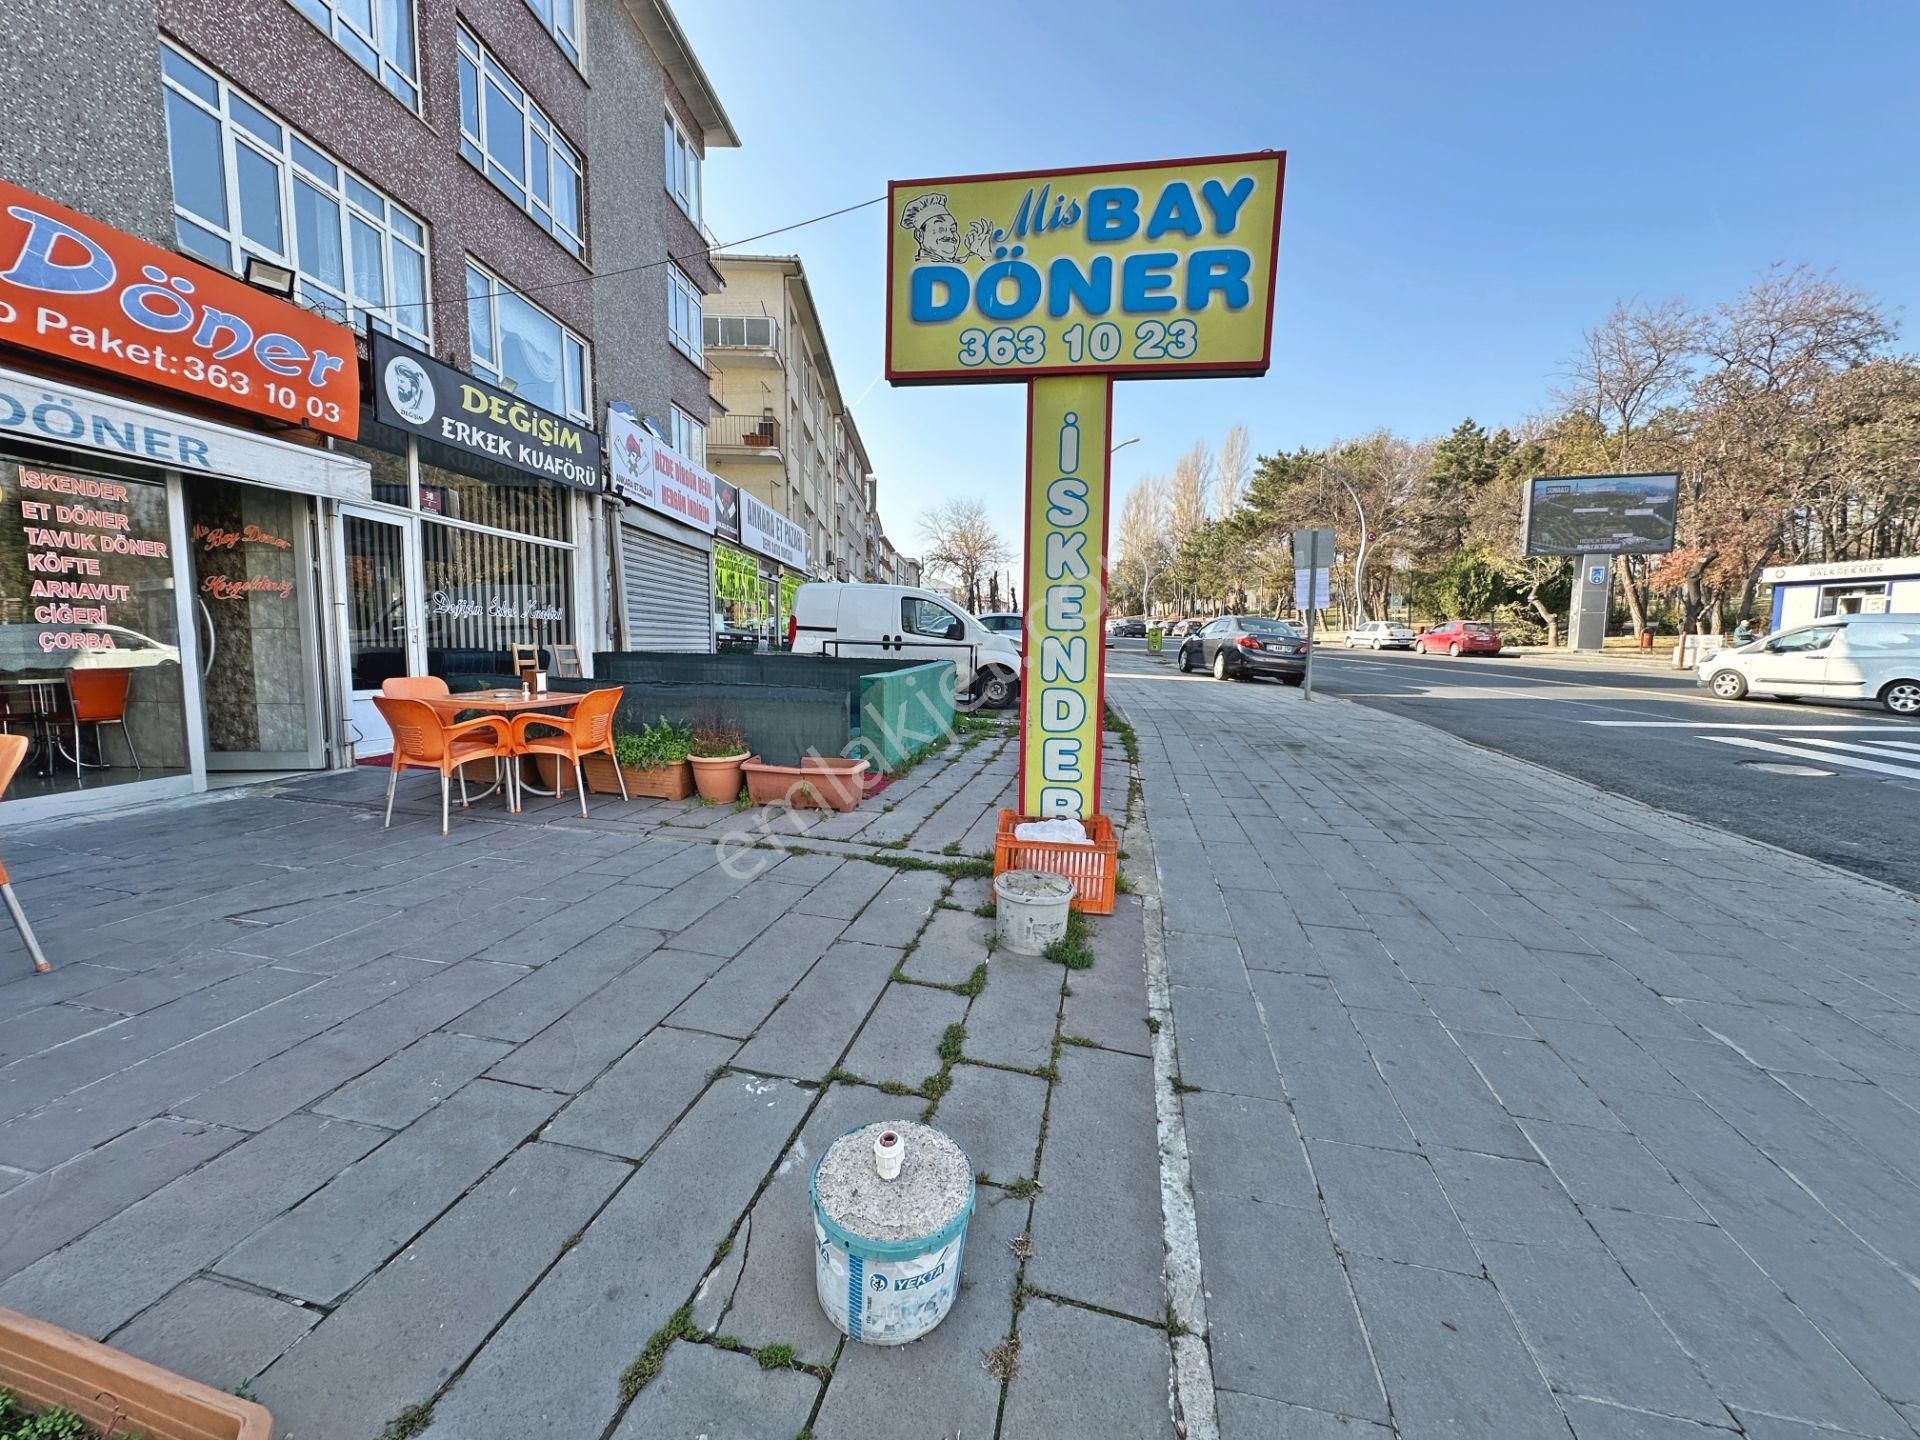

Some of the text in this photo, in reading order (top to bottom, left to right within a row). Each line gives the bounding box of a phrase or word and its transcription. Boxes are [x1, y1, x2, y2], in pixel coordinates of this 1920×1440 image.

[993, 177, 1255, 243] Mis BAY
[0, 205, 344, 388] Döner
[911, 245, 1252, 322] DÖNER
[958, 318, 1198, 367] 363 10 23
[264, 382, 296, 410] 10
[306, 395, 341, 423] 03
[459, 384, 583, 454] DEĞİŞİM
[0, 393, 213, 468] DÖNER
[441, 416, 514, 459] ERKEK
[518, 444, 597, 488] KUAFÖRÜ
[18, 465, 129, 502] İSKENDER
[21, 500, 131, 531] ET DÖNER
[23, 526, 169, 558] TAVUK DÖNER
[27, 553, 101, 575] KÖFTE
[30, 579, 130, 602] ARNAVUT
[34, 603, 108, 625] CİĞERİ
[1040, 411, 1090, 820] İSKENDER
[38, 630, 117, 653] ÇORBA
[895, 1263, 944, 1291] YEKTA
